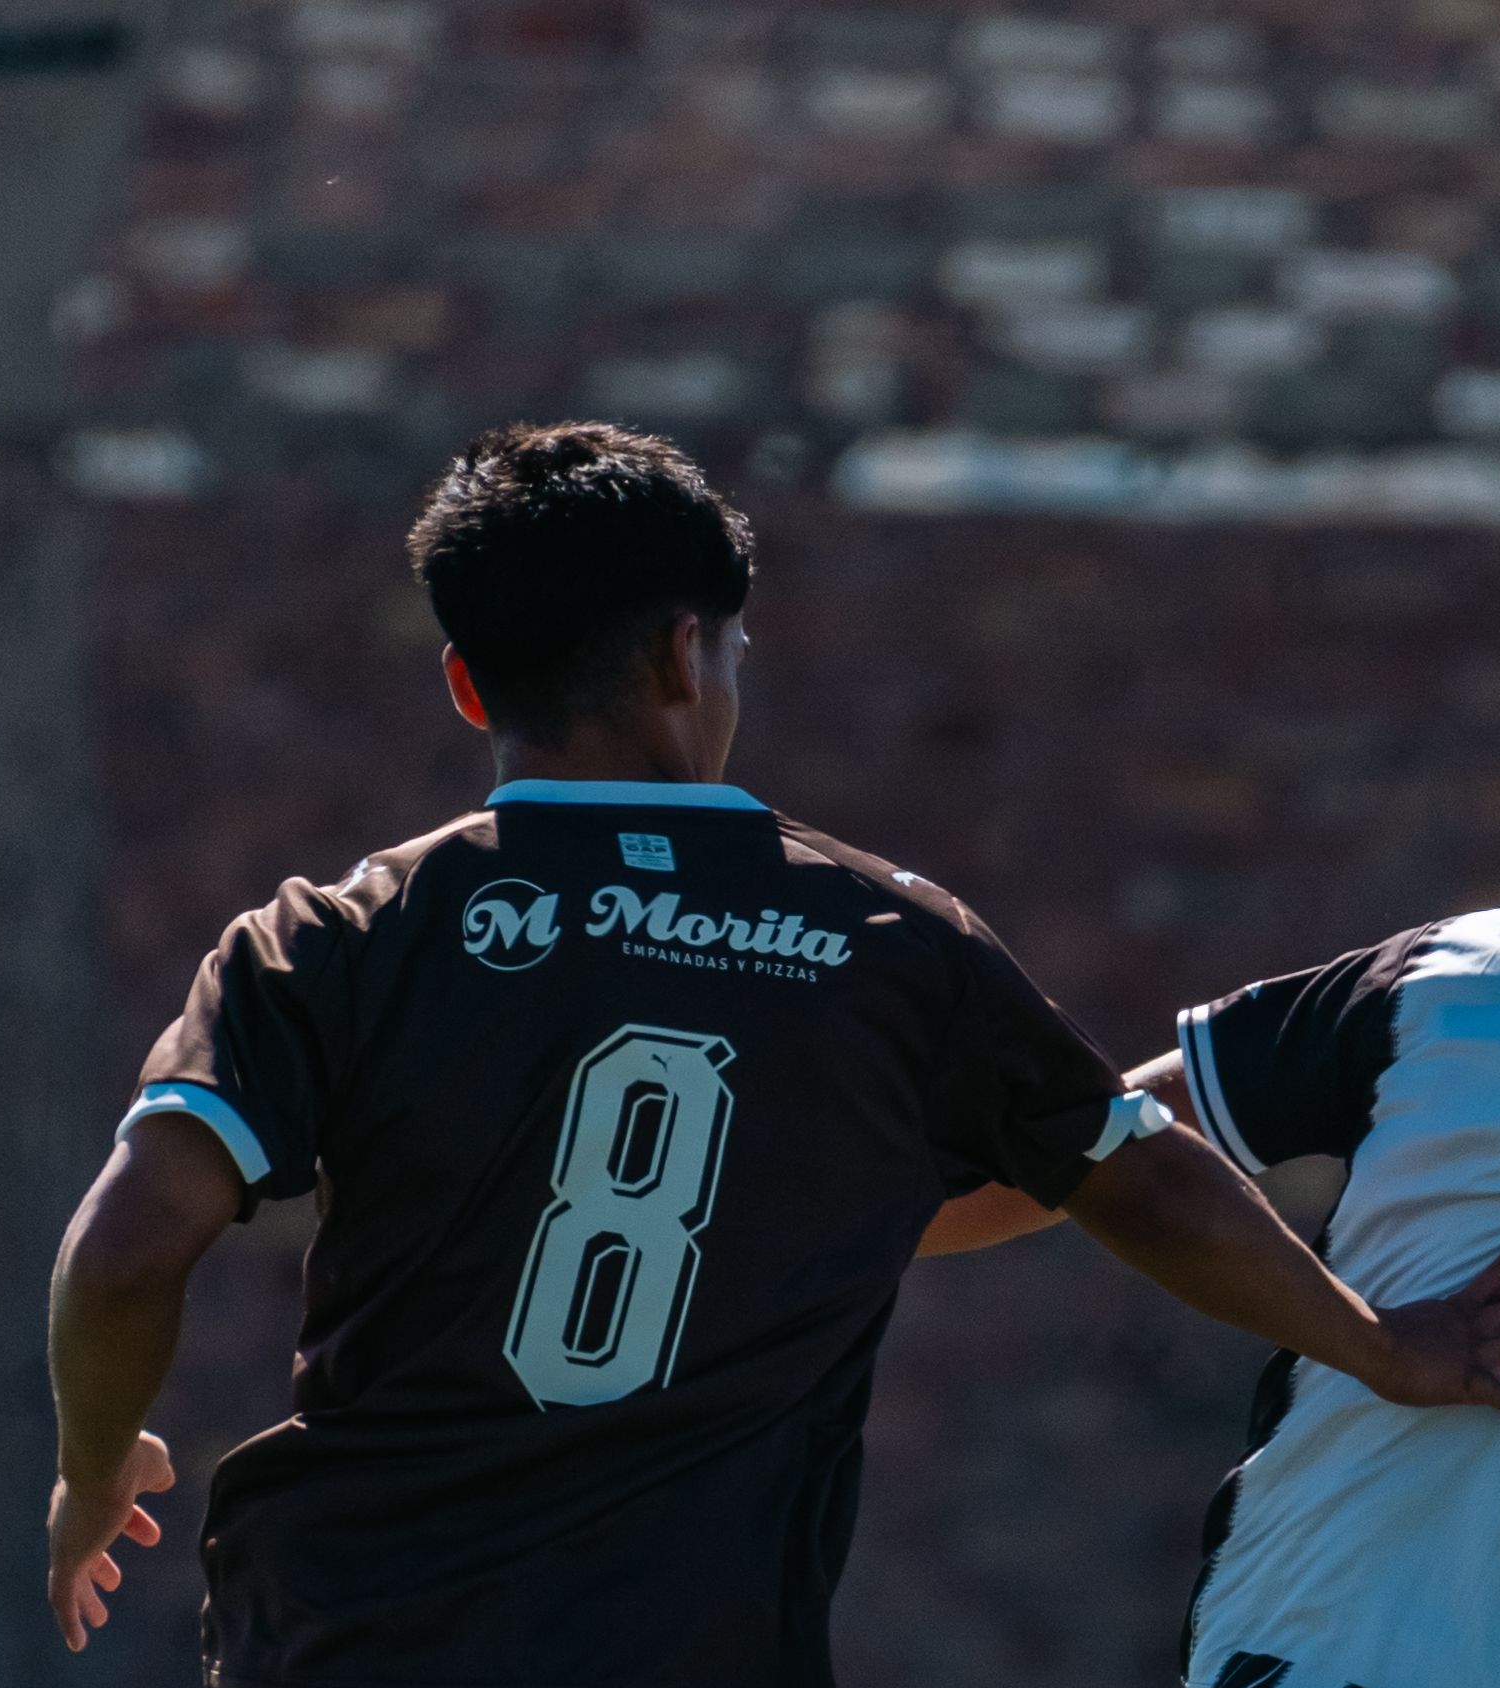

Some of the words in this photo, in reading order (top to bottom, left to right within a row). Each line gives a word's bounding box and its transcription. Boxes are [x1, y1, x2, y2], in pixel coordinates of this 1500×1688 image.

[463, 893, 561, 954] M
[585, 885, 852, 967] Morita
[622, 942, 728, 971] EMPANADAS
[737, 960, 747, 973] Y
[754, 961, 818, 983] PIZZAS
[503, 1023, 737, 1412] 8
